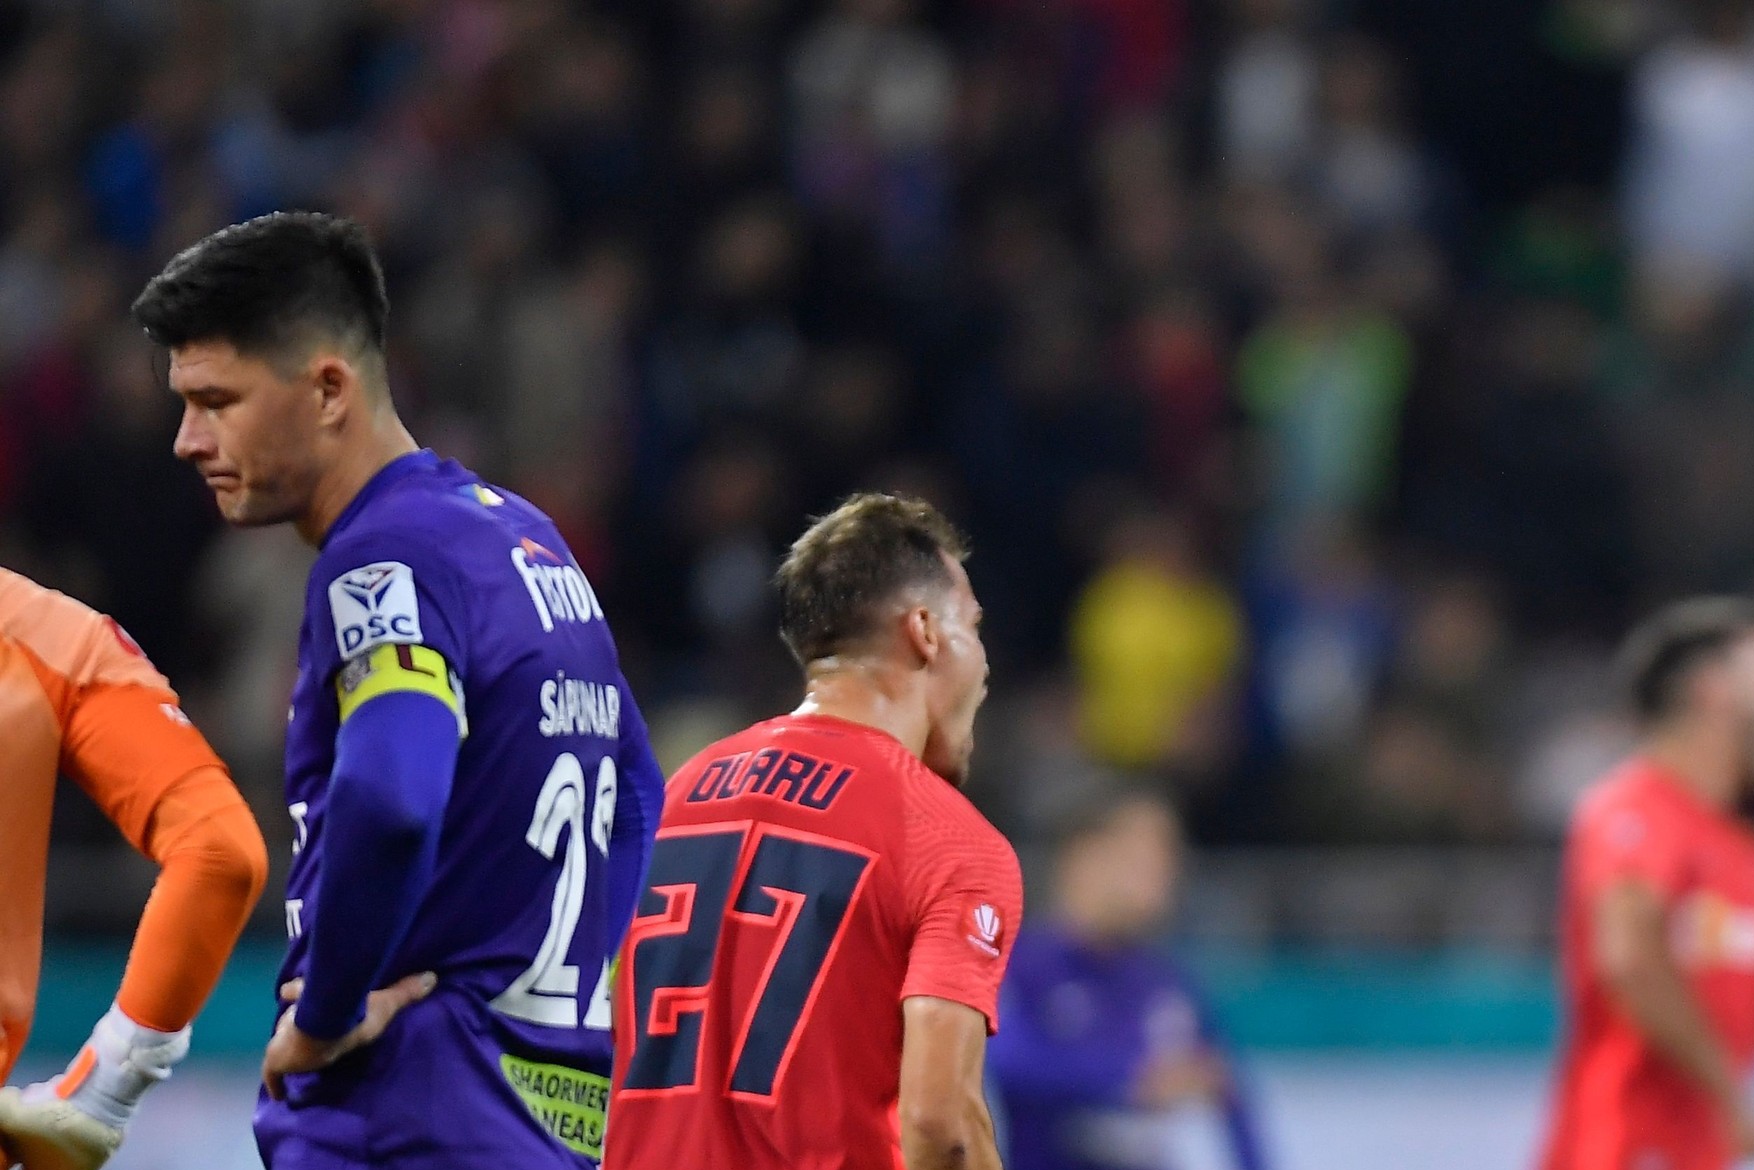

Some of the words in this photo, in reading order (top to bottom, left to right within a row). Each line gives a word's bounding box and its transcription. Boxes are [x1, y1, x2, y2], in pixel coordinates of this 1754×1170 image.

[343, 613, 414, 652] DSC
[686, 747, 857, 812] OLARU
[617, 819, 881, 1107] 27
